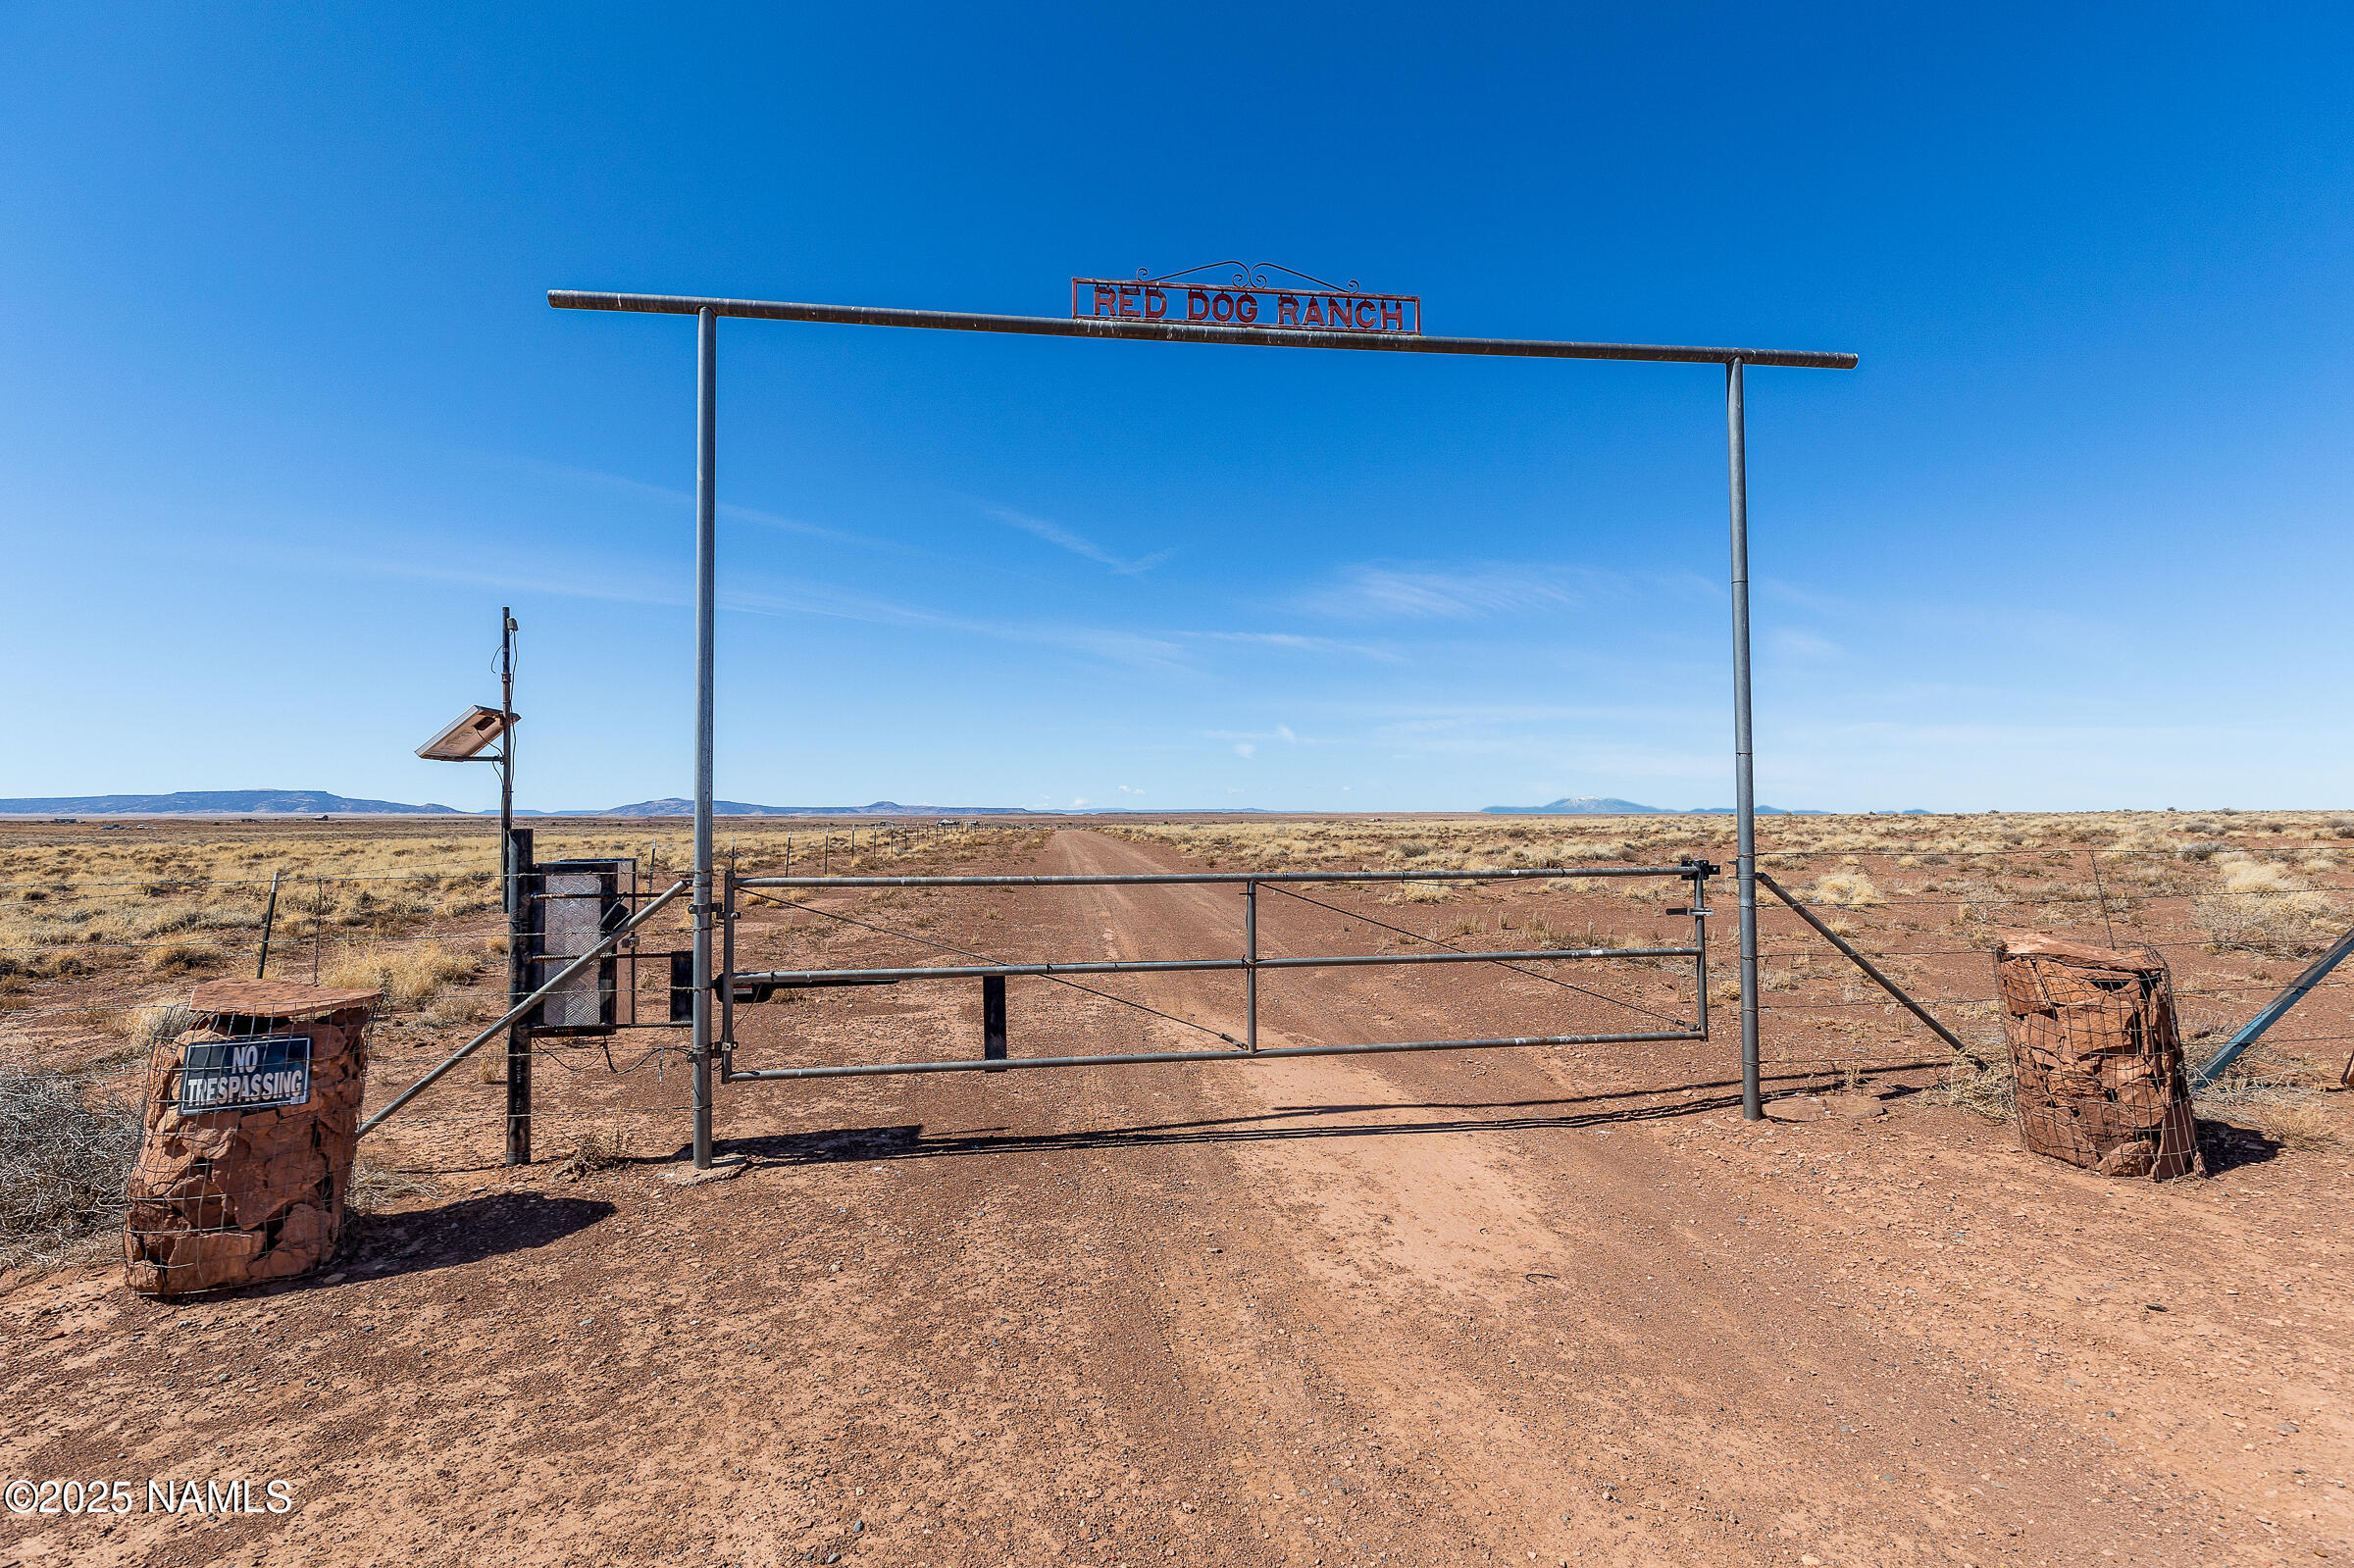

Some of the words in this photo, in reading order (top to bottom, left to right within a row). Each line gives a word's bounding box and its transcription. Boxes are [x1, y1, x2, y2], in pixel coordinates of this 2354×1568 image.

[1094, 286, 1167, 319] RED
[1187, 289, 1257, 323] DOG
[1277, 295, 1404, 330] RANCH
[230, 1045, 258, 1075] NO
[187, 1070, 303, 1107] TRESPASSING
